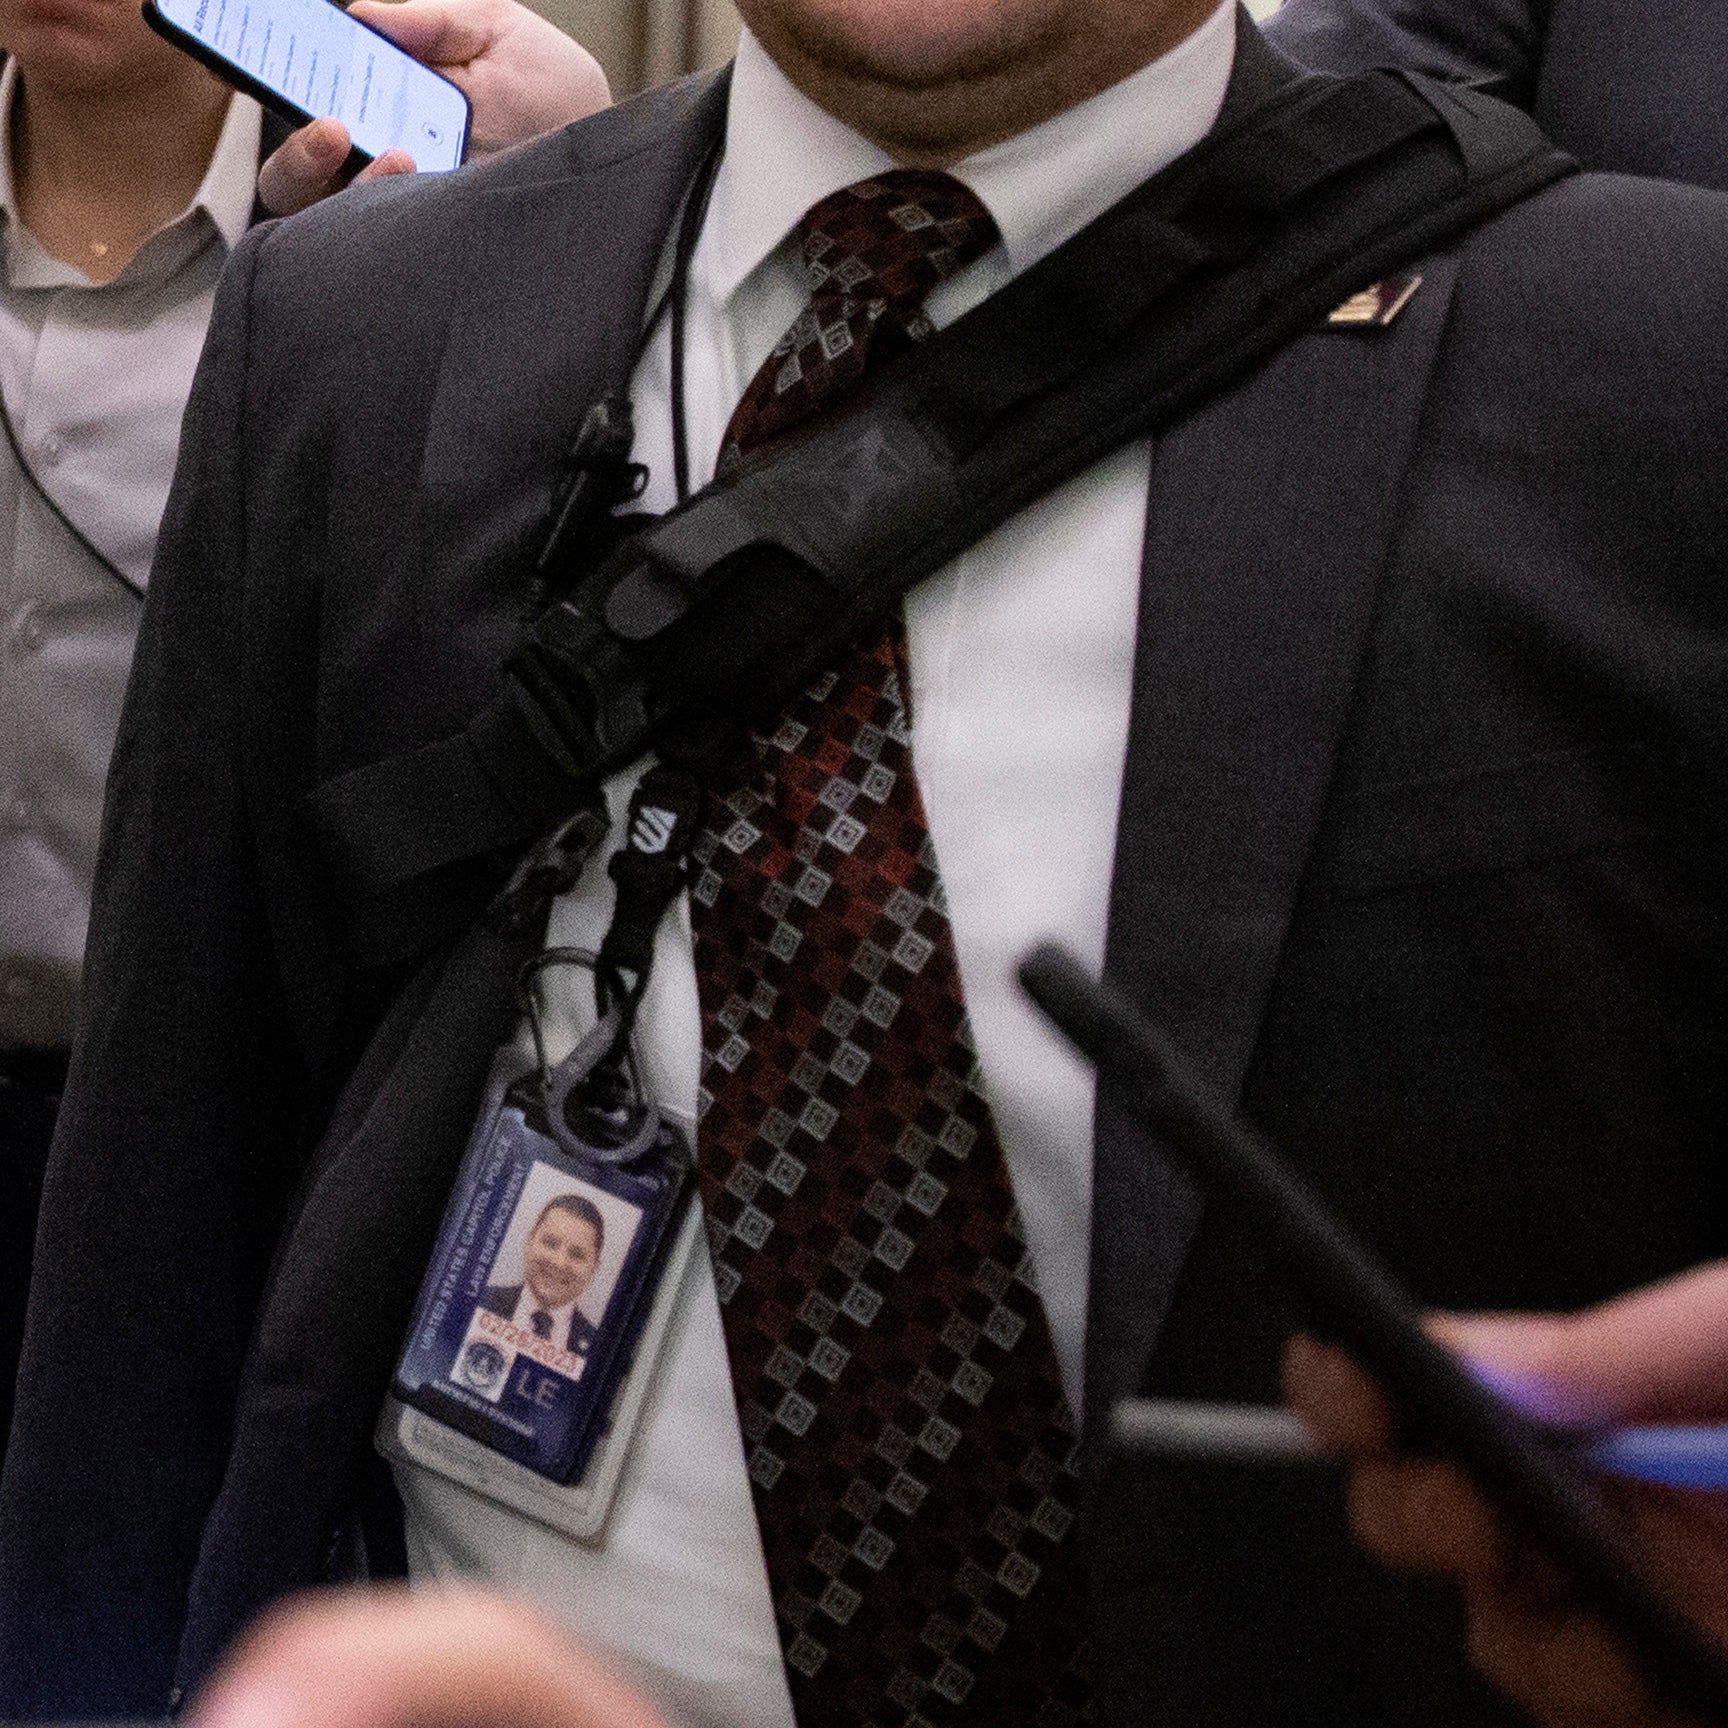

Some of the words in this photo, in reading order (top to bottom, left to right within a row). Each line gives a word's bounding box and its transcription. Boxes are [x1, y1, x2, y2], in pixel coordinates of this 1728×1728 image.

[420, 1300, 448, 1349] UNITED
[440, 1244, 469, 1299] STATES
[461, 1186, 492, 1245] CAPITOL
[483, 1134, 512, 1186] POLICE
[467, 1264, 487, 1298] LAW
[479, 1163, 526, 1264] ENFORCEMENT
[516, 1368, 561, 1410] LE
